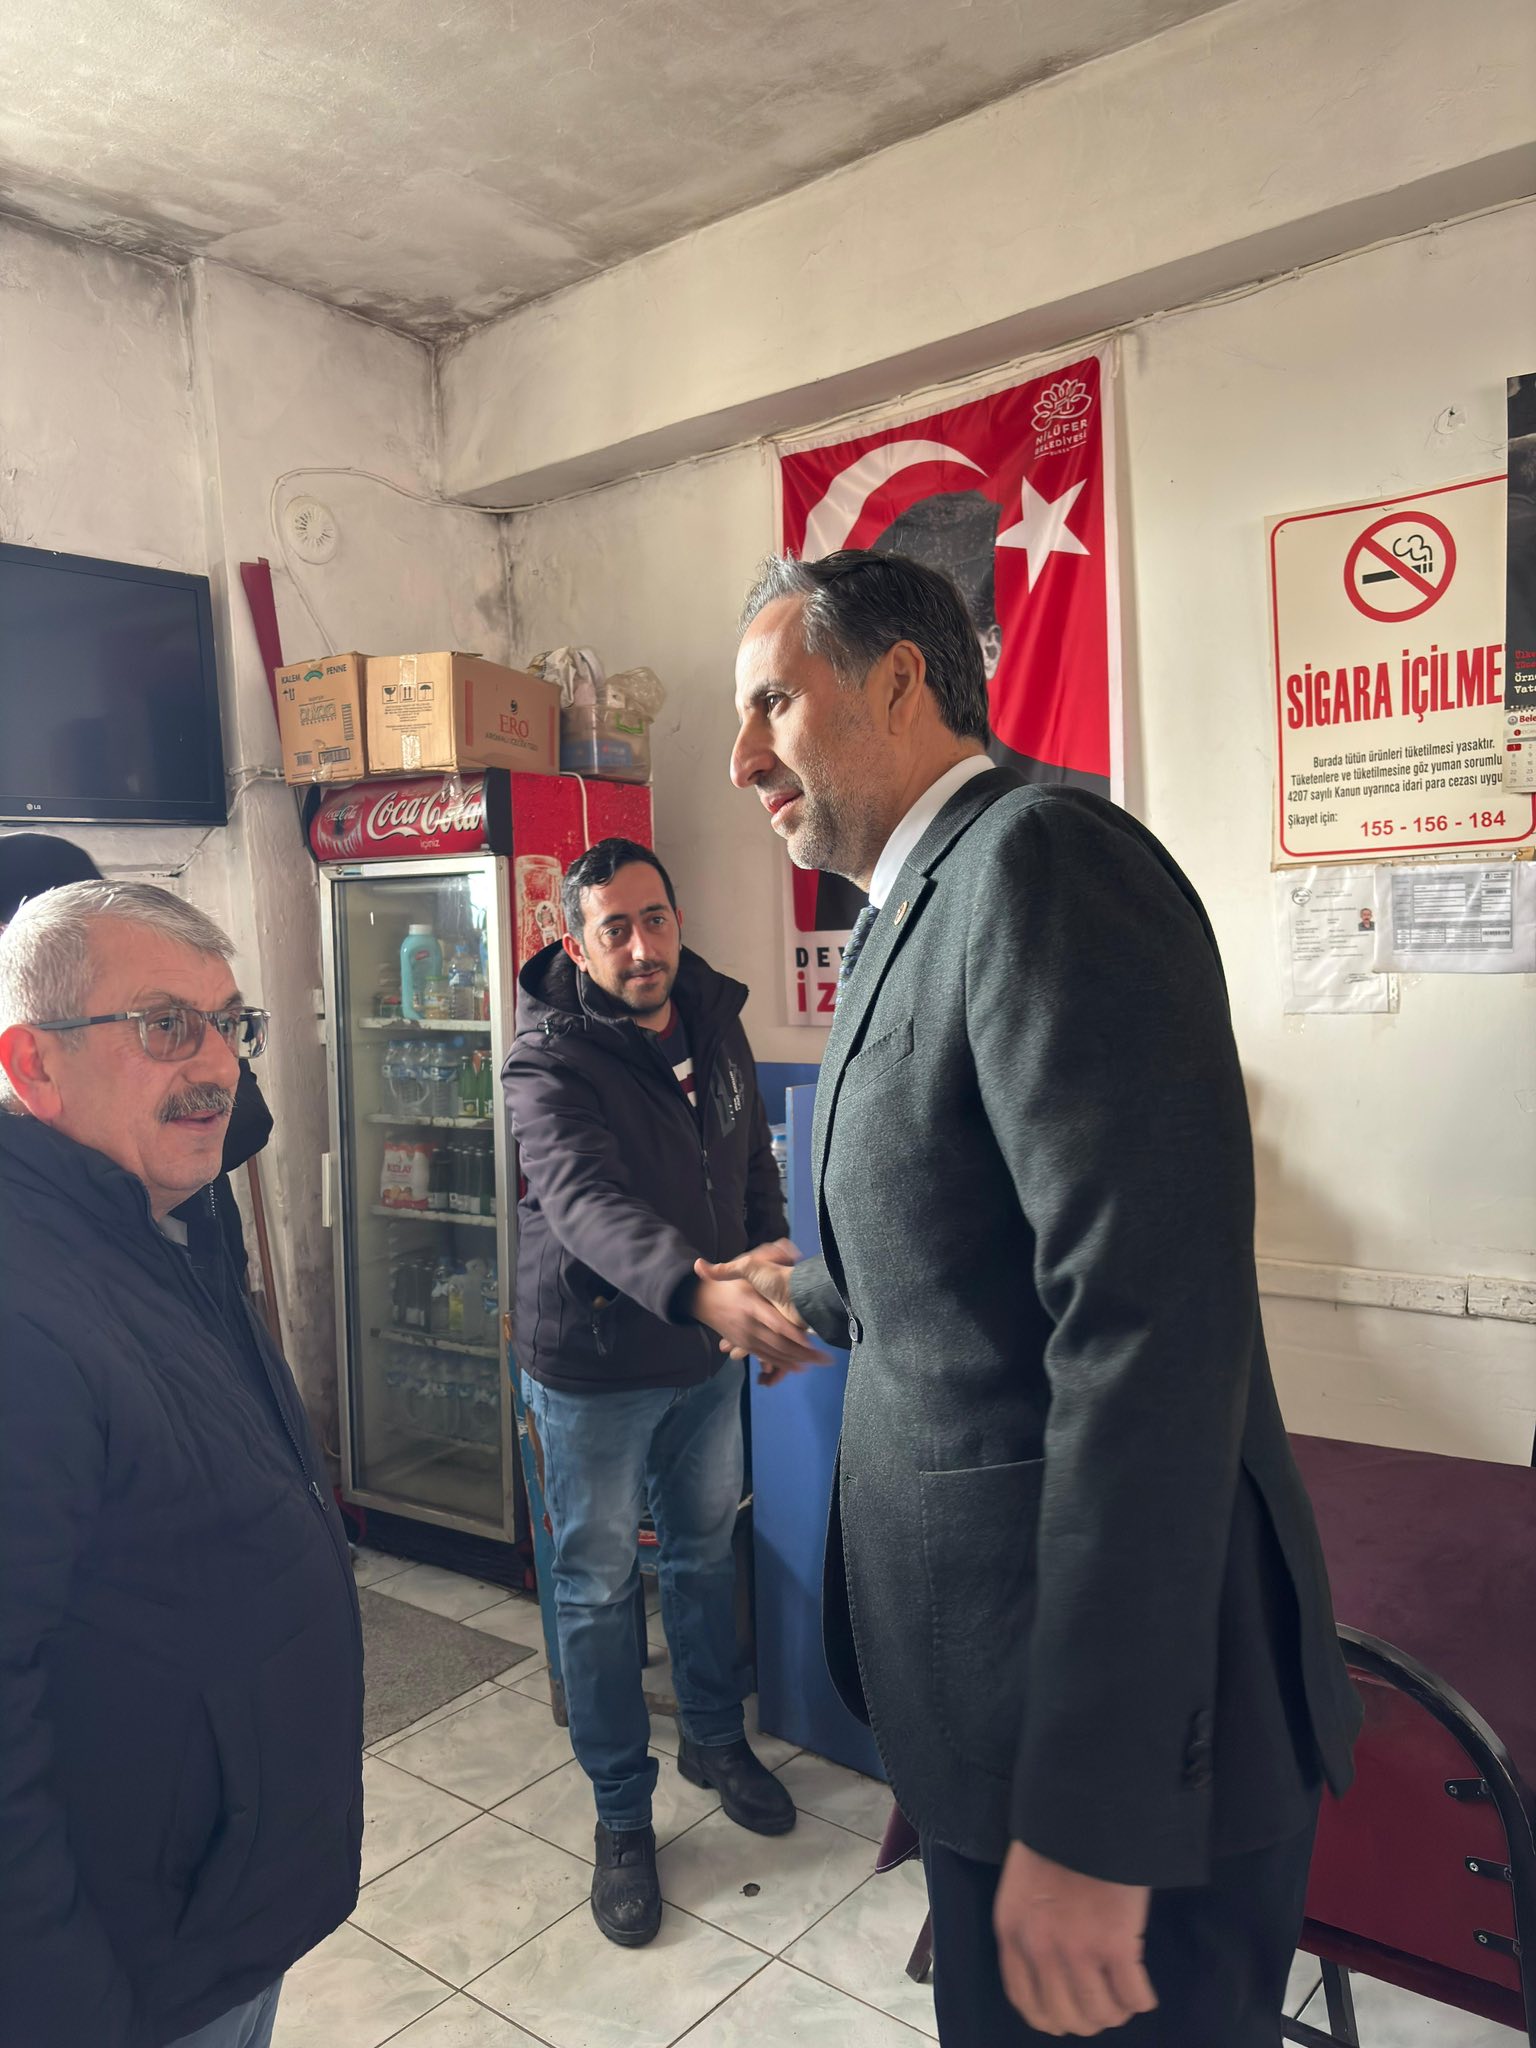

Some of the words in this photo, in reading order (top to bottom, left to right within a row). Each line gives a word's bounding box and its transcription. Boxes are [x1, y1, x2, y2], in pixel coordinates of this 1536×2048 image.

[1034, 430, 1087, 455] BELEDİYESİ
[1035, 419, 1088, 446] NİLÜFER
[326, 663, 347, 675] PENNE
[1514, 672, 1536, 682] Örn
[1286, 662, 1393, 729] SİGARA
[1401, 643, 1505, 723] İÇİLME
[499, 713, 529, 738] ERO
[1313, 754, 1343, 768] Burada
[1345, 752, 1366, 765] tütün
[1368, 747, 1403, 762] ürünleri
[1405, 741, 1454, 758] tüketilmesi
[1456, 737, 1495, 755] yasaktır.
[1291, 772, 1340, 786] Tüketenlere
[1341, 771, 1352, 781] ve
[1353, 763, 1411, 780] tüketilmesine
[1413, 761, 1429, 776] göz
[1431, 759, 1462, 775] yuman
[1464, 753, 1503, 769] sorumlu
[1287, 789, 1308, 802] 4207
[1310, 787, 1332, 802] sayılı
[1334, 786, 1361, 798] Kanun
[1363, 782, 1400, 797] uyarınca
[1402, 778, 1423, 792] idari
[1425, 778, 1446, 792] para
[1448, 775, 1478, 788] cezası
[366, 781, 484, 840] Coca-Cola
[1287, 813, 1318, 829] Şikayet
[1320, 811, 1338, 826] için:
[1360, 819, 1394, 837] 155
[1413, 815, 1448, 833] 156
[1469, 810, 1506, 829] 184
